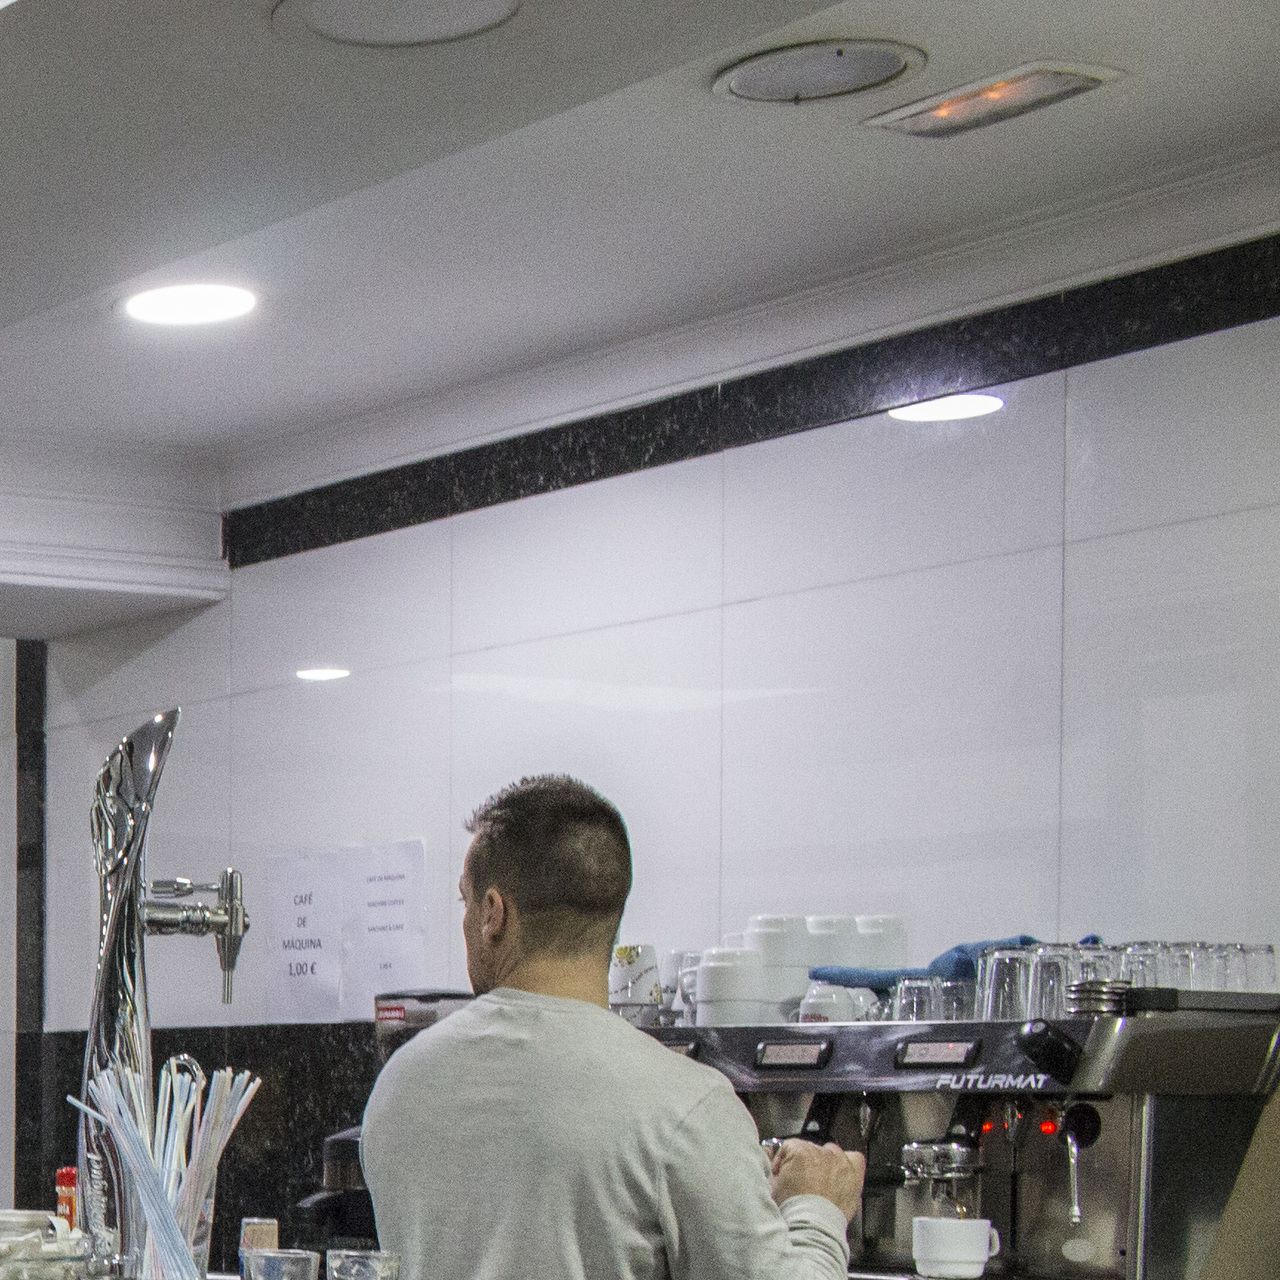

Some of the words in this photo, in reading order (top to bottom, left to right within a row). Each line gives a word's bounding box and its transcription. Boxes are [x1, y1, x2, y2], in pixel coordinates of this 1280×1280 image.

[293, 890, 313, 906] CAFÉ
[296, 916, 307, 928] DE
[935, 1073, 1051, 1090] FUTURMAT
